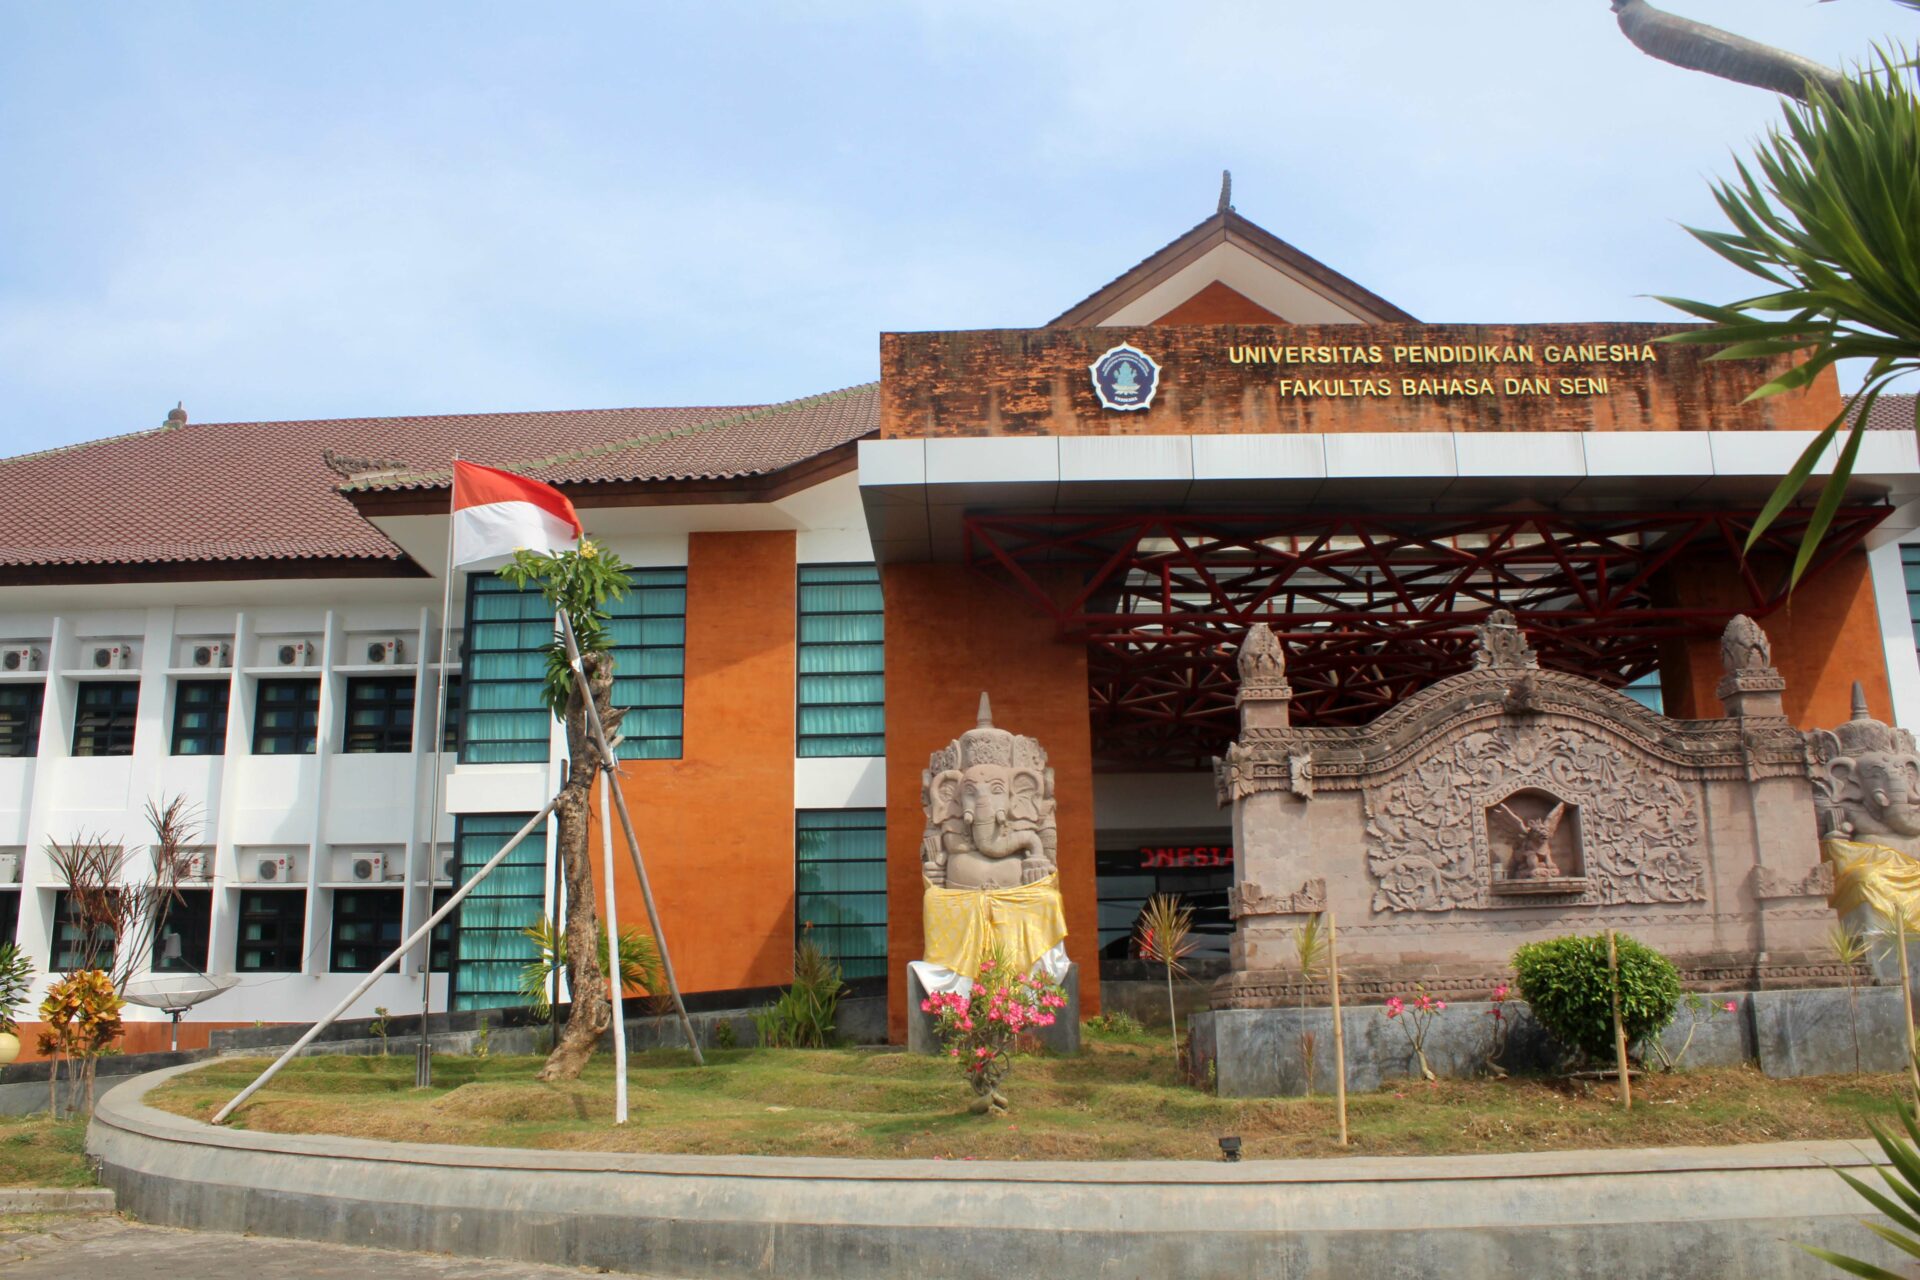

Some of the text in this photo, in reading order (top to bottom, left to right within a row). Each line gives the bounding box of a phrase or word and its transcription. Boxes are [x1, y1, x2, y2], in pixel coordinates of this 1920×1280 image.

[1229, 345, 1656, 364] UNIVERSITAS PENDIDIKAN GANESHA
[1280, 378, 1608, 396] FAKULTAS BAHASA DAN SENI
